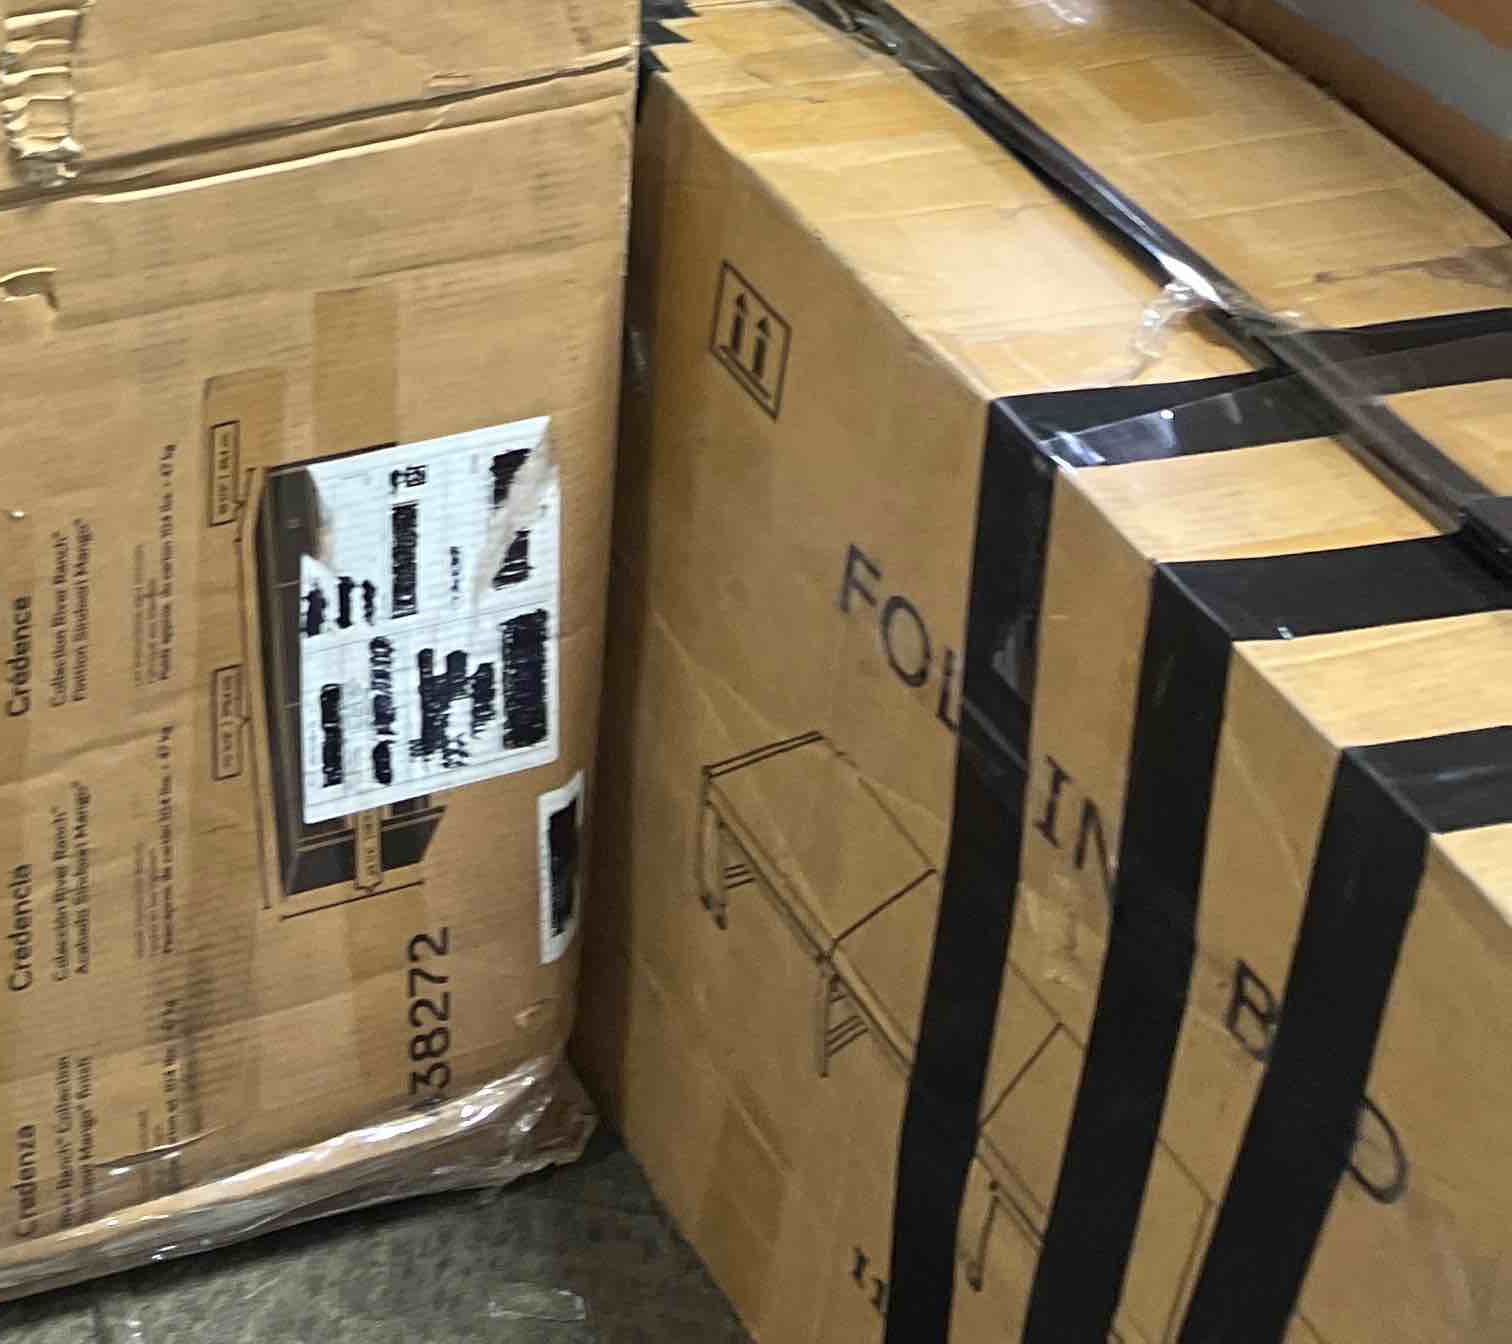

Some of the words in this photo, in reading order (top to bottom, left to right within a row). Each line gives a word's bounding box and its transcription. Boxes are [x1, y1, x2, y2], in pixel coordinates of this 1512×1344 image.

[51, 590, 66, 627] River
[5, 596, 32, 718] Crédence
[50, 630, 66, 707] Collection
[7, 864, 32, 992] Credencia
[56, 1057, 71, 1133] Collection
[12, 1124, 37, 1239] Credenza
